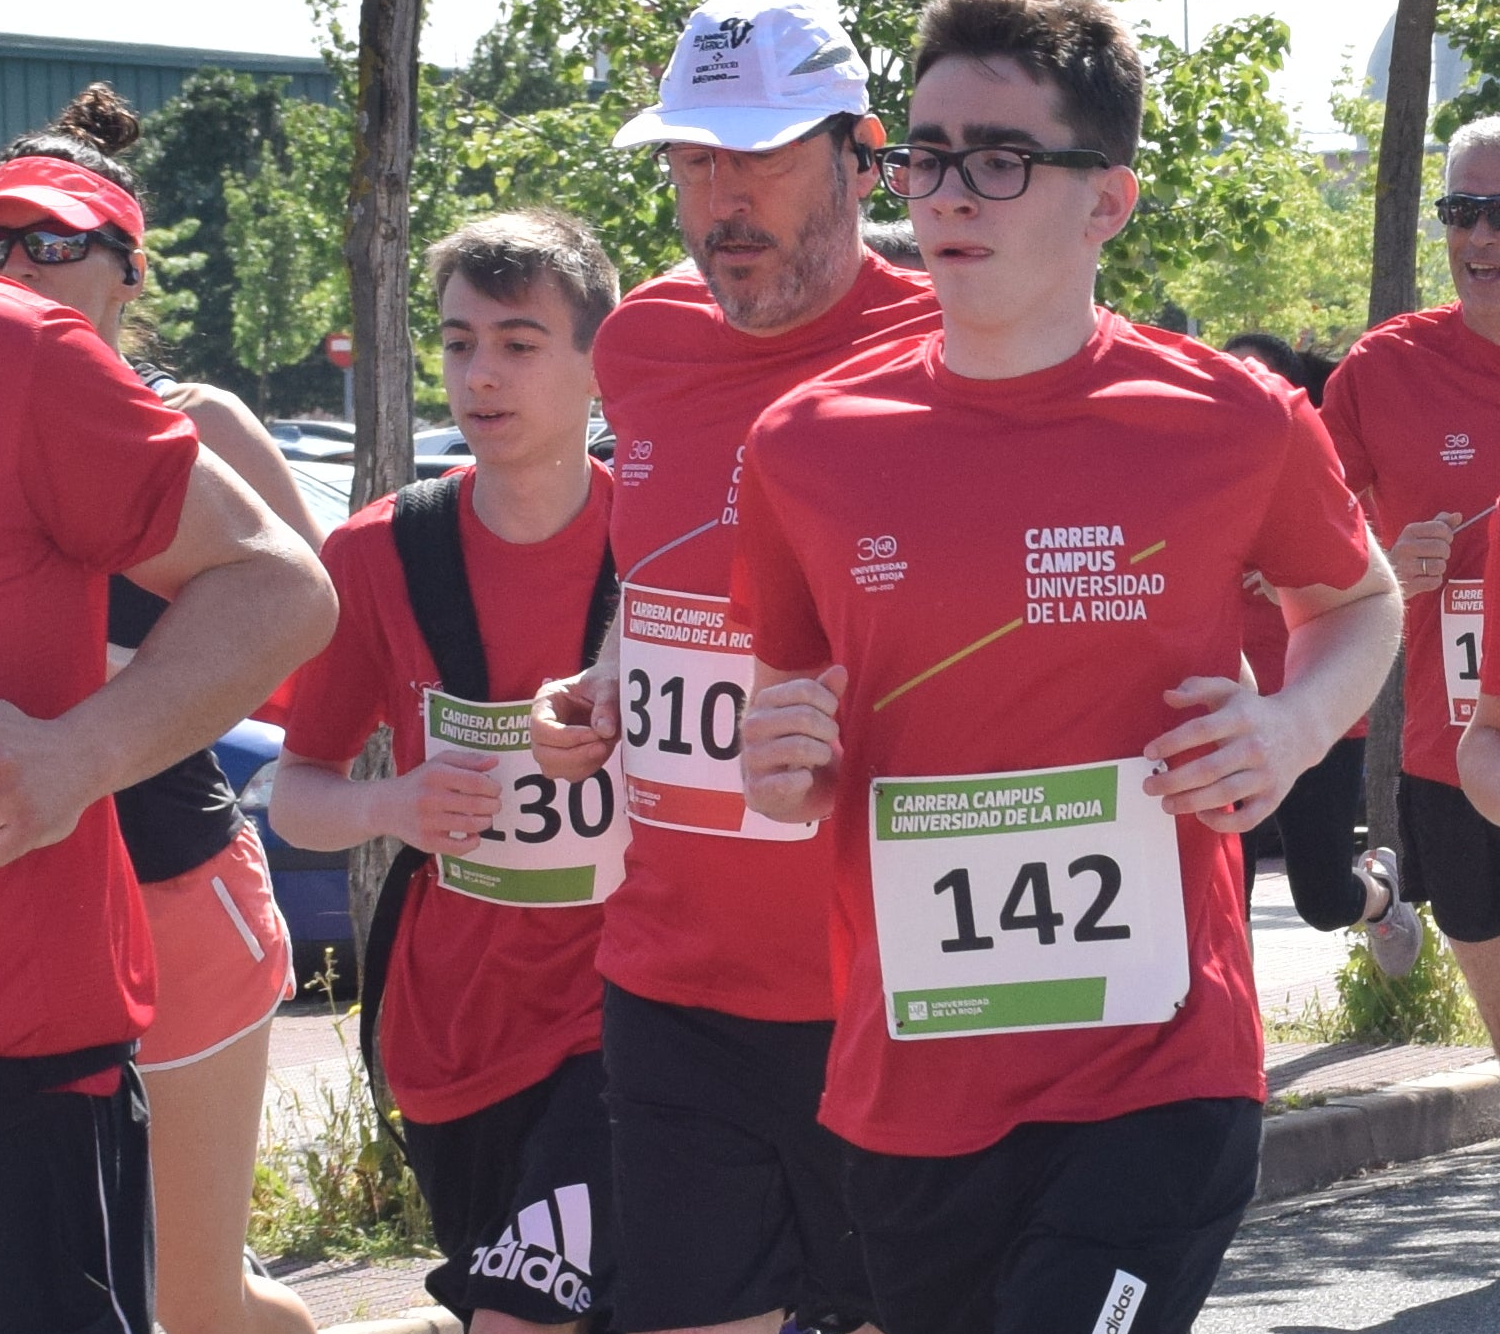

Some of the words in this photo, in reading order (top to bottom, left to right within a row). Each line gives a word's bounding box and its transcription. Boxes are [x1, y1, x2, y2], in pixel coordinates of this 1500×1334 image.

[1025, 525, 1124, 550] CARRERA
[850, 561, 908, 576] UNIVERSIDAD
[1025, 550, 1115, 574] CAMPUS
[855, 575, 866, 585] DE
[867, 573, 879, 584] LA
[879, 571, 904, 582] RIOJA
[1026, 573, 1165, 599] UNIVERSIDAD
[1451, 600, 1483, 611] UNIVER
[1452, 588, 1483, 600] CARRE
[631, 600, 672, 622] CARRERA
[673, 608, 724, 628] CAMPUS
[1027, 602, 1054, 624] DE
[1059, 601, 1086, 623] LA
[1091, 599, 1147, 622] RIOJA
[629, 618, 690, 642] UNIVERSIDAD
[691, 630, 708, 644] DE
[709, 632, 727, 647] LA
[729, 632, 753, 649] RIO
[441, 707, 493, 730] CARRERA
[497, 717, 531, 730] CAM
[440, 722, 519, 745] UNIVERSIDAD
[480, 767, 614, 843] 30
[893, 793, 969, 813] CARRERA
[972, 786, 1045, 808] CAMPUS
[891, 810, 1002, 833] UNIVERSIDAD
[1005, 808, 1027, 826] DE
[1030, 805, 1053, 823] LA
[1055, 799, 1103, 821] RIOJA
[933, 853, 1131, 953] 142
[931, 998, 990, 1009] UNIVERSIDAD
[932, 1008, 945, 1018] DE
[946, 1007, 956, 1016] LA
[957, 1005, 983, 1017] RIOJA
